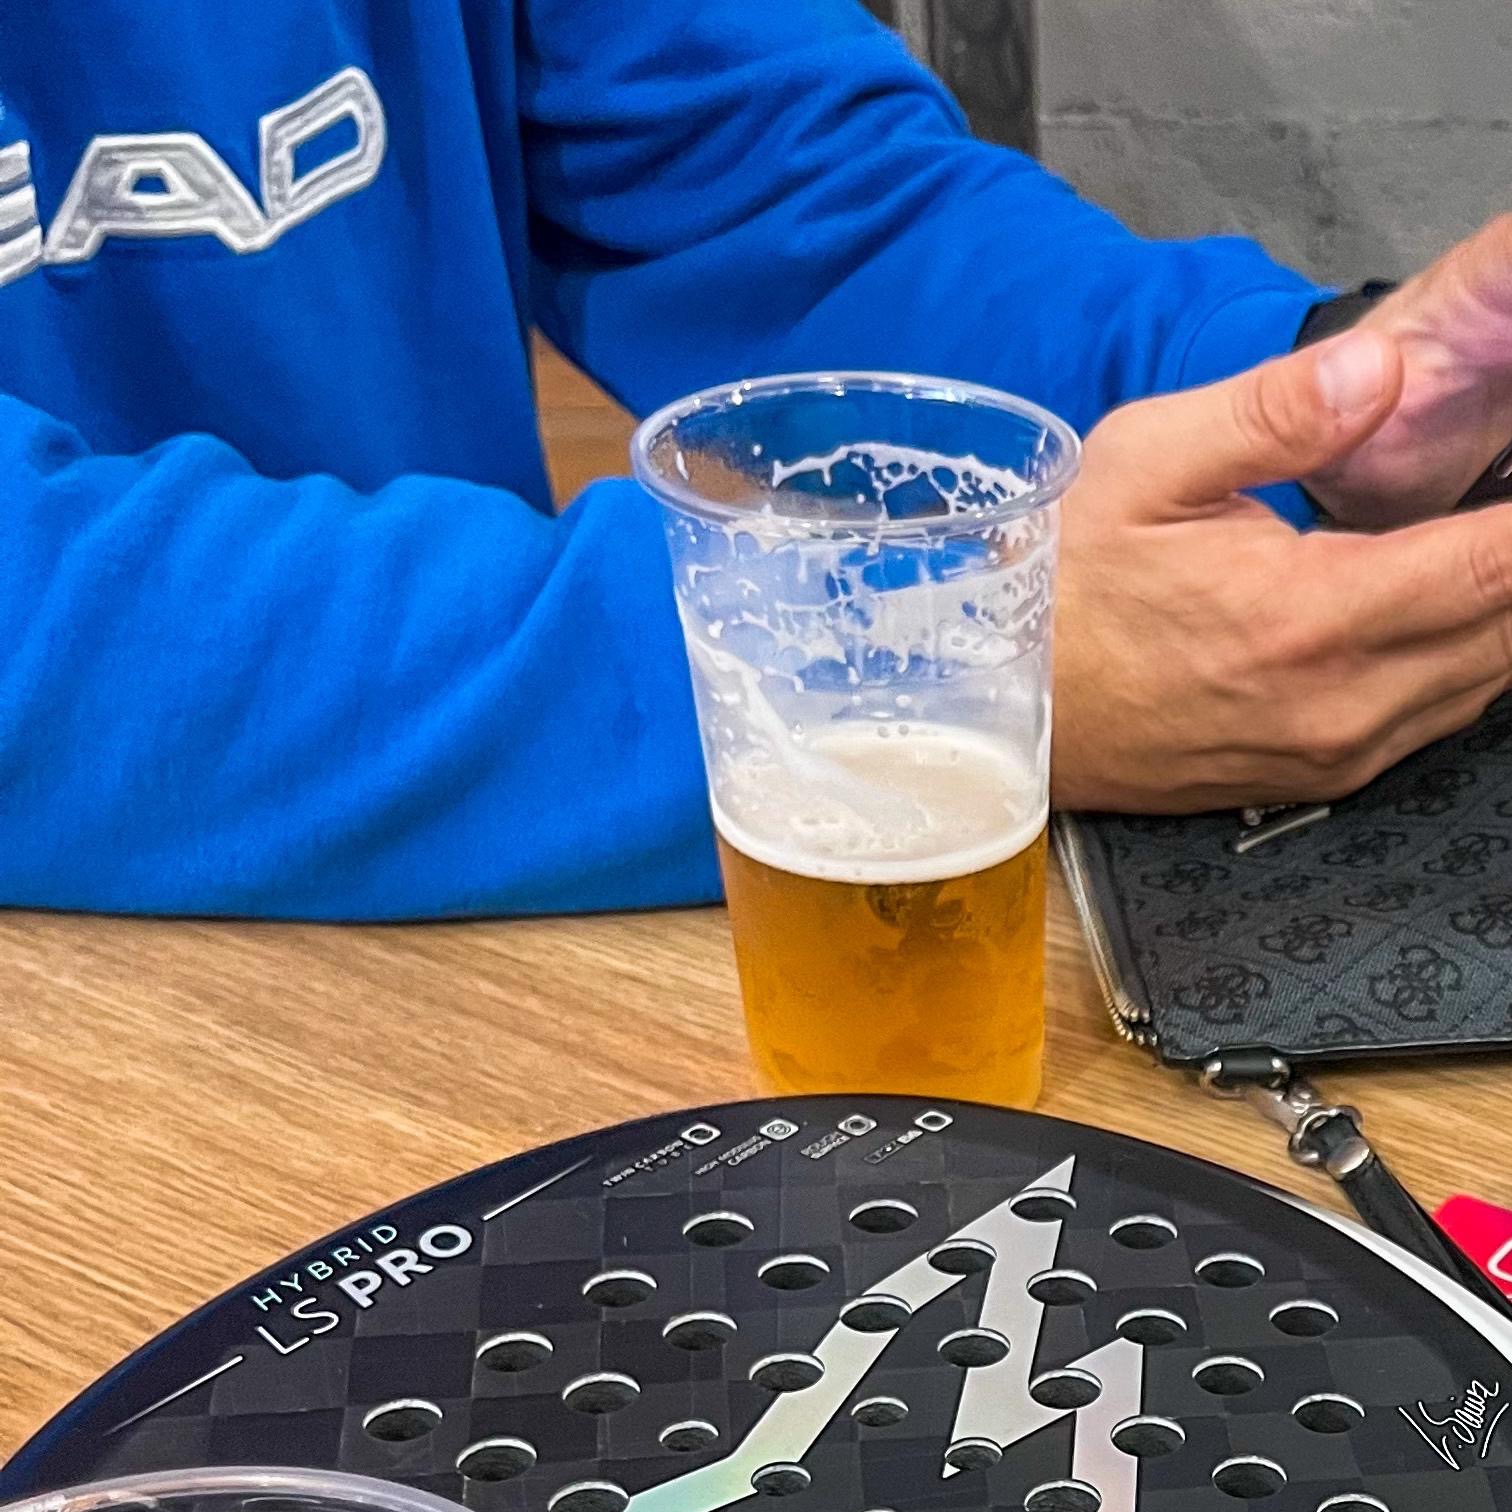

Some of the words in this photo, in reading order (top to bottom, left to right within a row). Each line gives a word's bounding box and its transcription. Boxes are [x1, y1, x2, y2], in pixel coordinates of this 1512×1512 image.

[252, 1224, 398, 1312] HYBRID
[256, 1297, 340, 1355] LS
[337, 1224, 473, 1309] PRO
